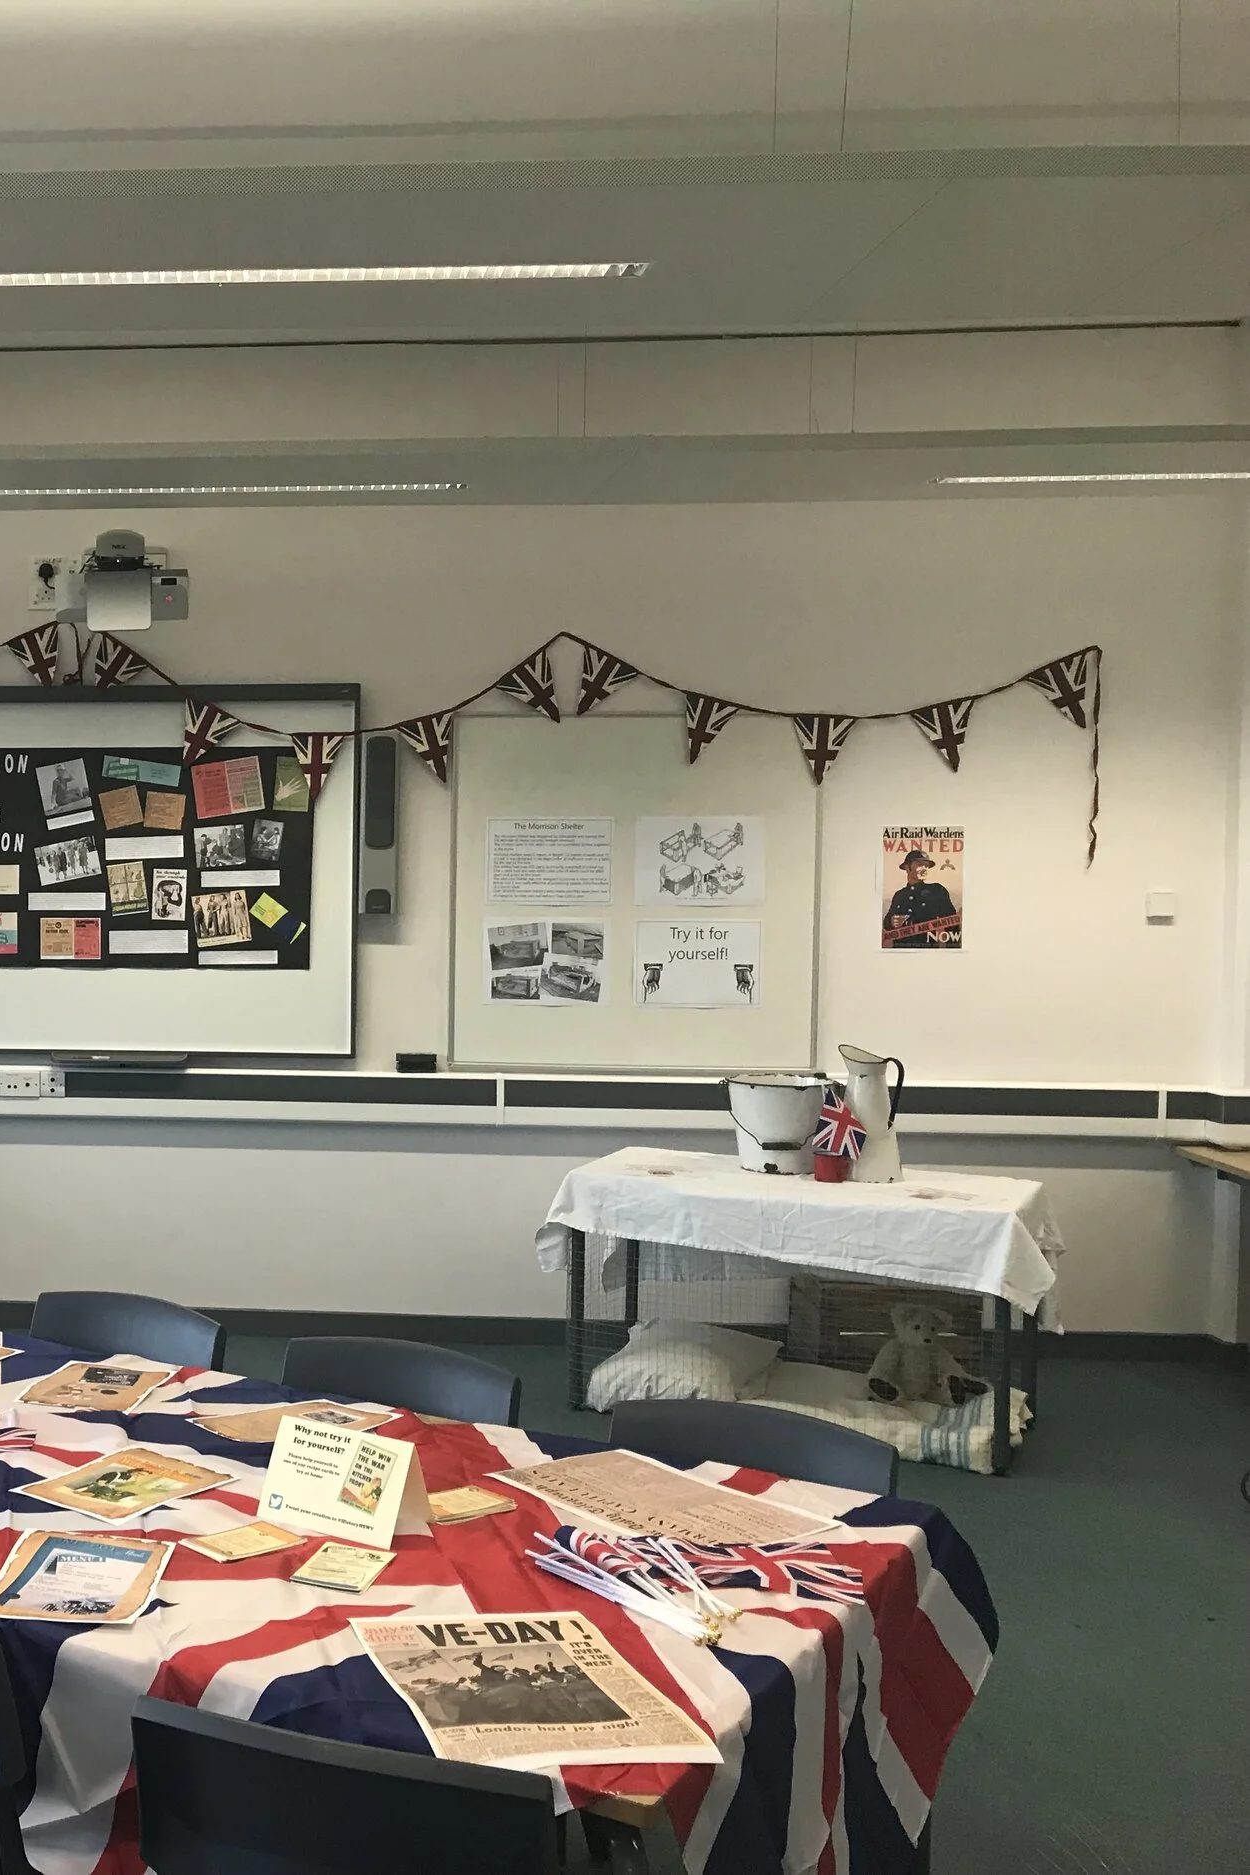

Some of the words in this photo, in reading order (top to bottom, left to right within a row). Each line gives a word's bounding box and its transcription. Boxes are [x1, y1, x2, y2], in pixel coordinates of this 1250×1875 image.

[883, 828, 900, 838] Air
[900, 827, 923, 838] Raid
[924, 827, 964, 838] Wardens
[882, 840, 964, 852] WANTED
[670, 926, 691, 943] Try
[695, 926, 704, 940] it
[709, 926, 729, 940] for
[926, 931, 962, 943] NOW
[668, 947, 728, 963] yourself!
[294, 1424, 312, 1435] Why
[330, 1434, 343, 1442] try
[294, 1436, 306, 1445] for
[307, 1441, 346, 1454] yourself?
[358, 1454, 370, 1464] THE
[371, 1460, 386, 1471] WAR
[361, 1446, 376, 1456] HELP
[378, 1453, 392, 1463] WIN
[348, 1478, 365, 1488] FRONT
[352, 1470, 372, 1483] KITCHEN
[416, 1620, 566, 1648] VE-DAY
[569, 1620, 593, 1640] !
[475, 1726, 532, 1734] London
[536, 1724, 566, 1732] had
[573, 1724, 596, 1733] joy
[602, 1720, 641, 1731] night
